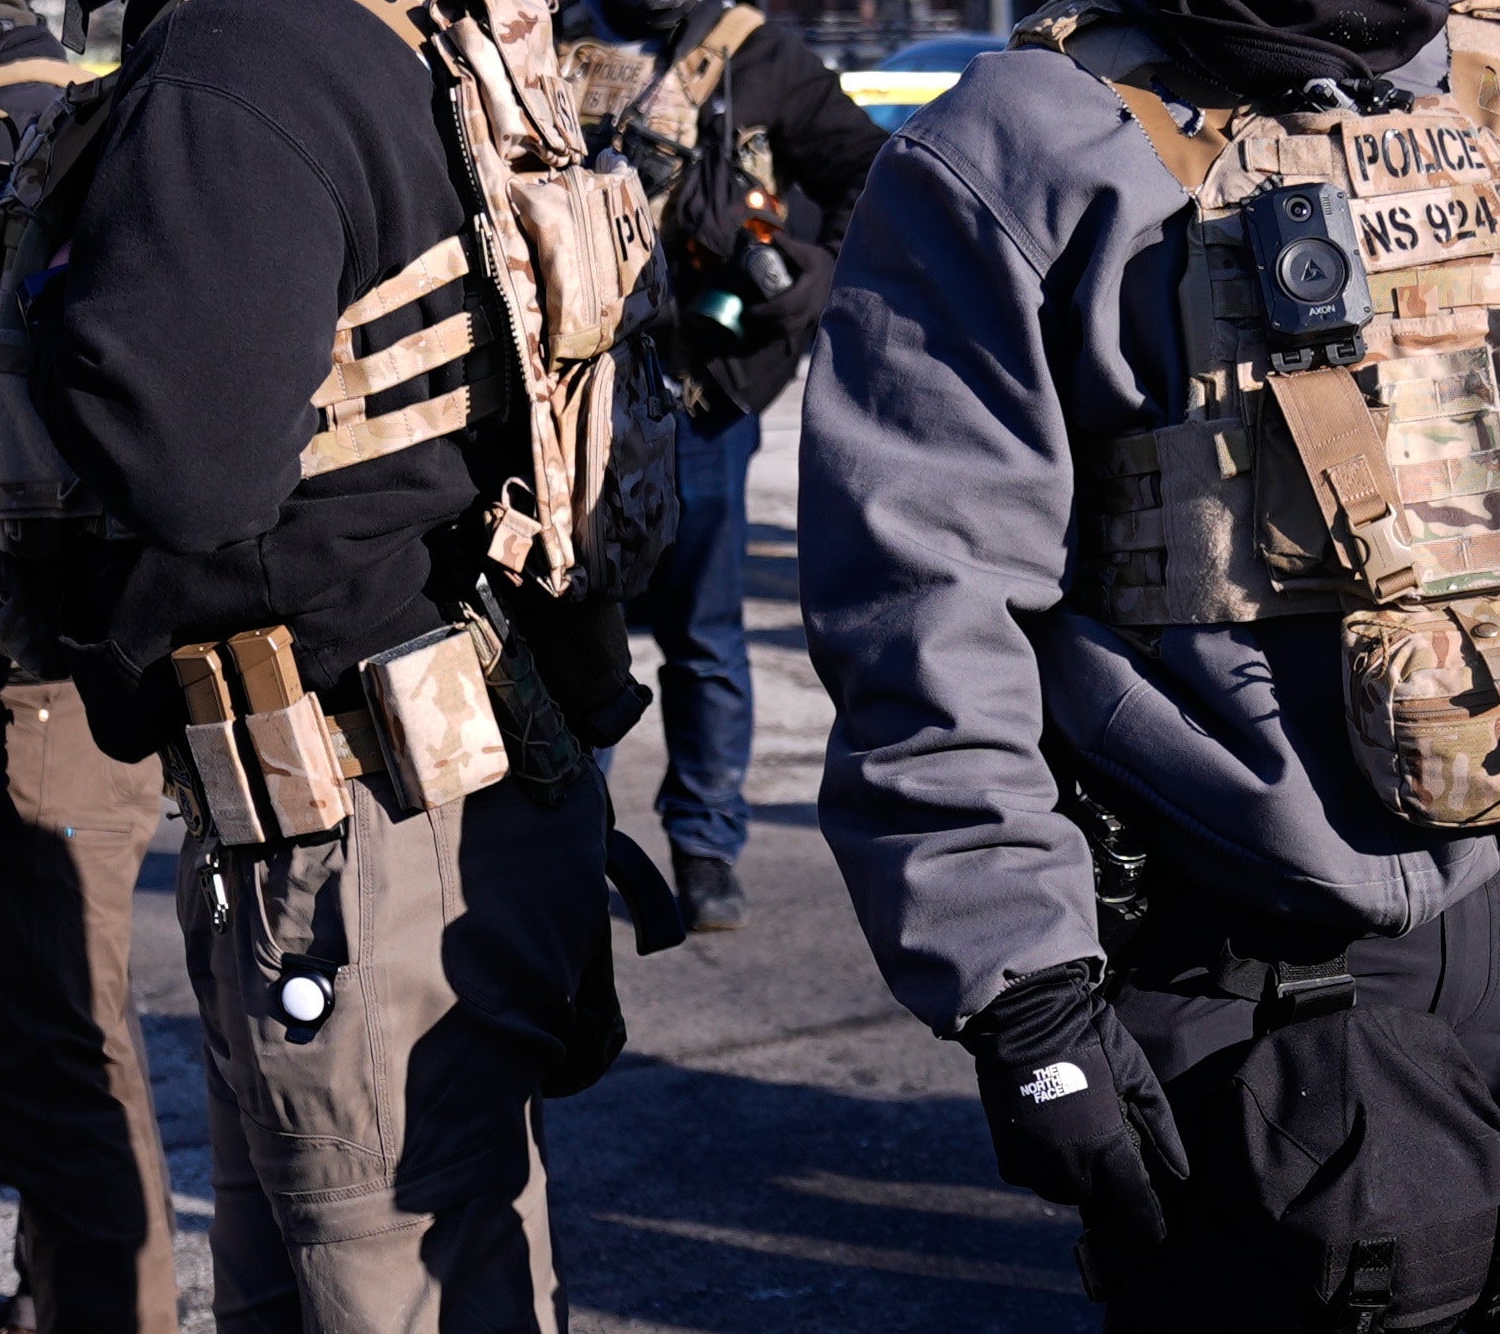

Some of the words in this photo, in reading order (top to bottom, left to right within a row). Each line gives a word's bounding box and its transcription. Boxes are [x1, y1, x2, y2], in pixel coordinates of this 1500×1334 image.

[593, 60, 643, 84] POLICE
[1354, 124, 1486, 182] POLICE
[1359, 205, 1420, 257] NS
[1426, 195, 1498, 245] 924
[1308, 303, 1337, 317] AXON
[1033, 1066, 1059, 1081] THE
[1020, 1074, 1061, 1097] NORTH
[1033, 1085, 1065, 1104] FACE
